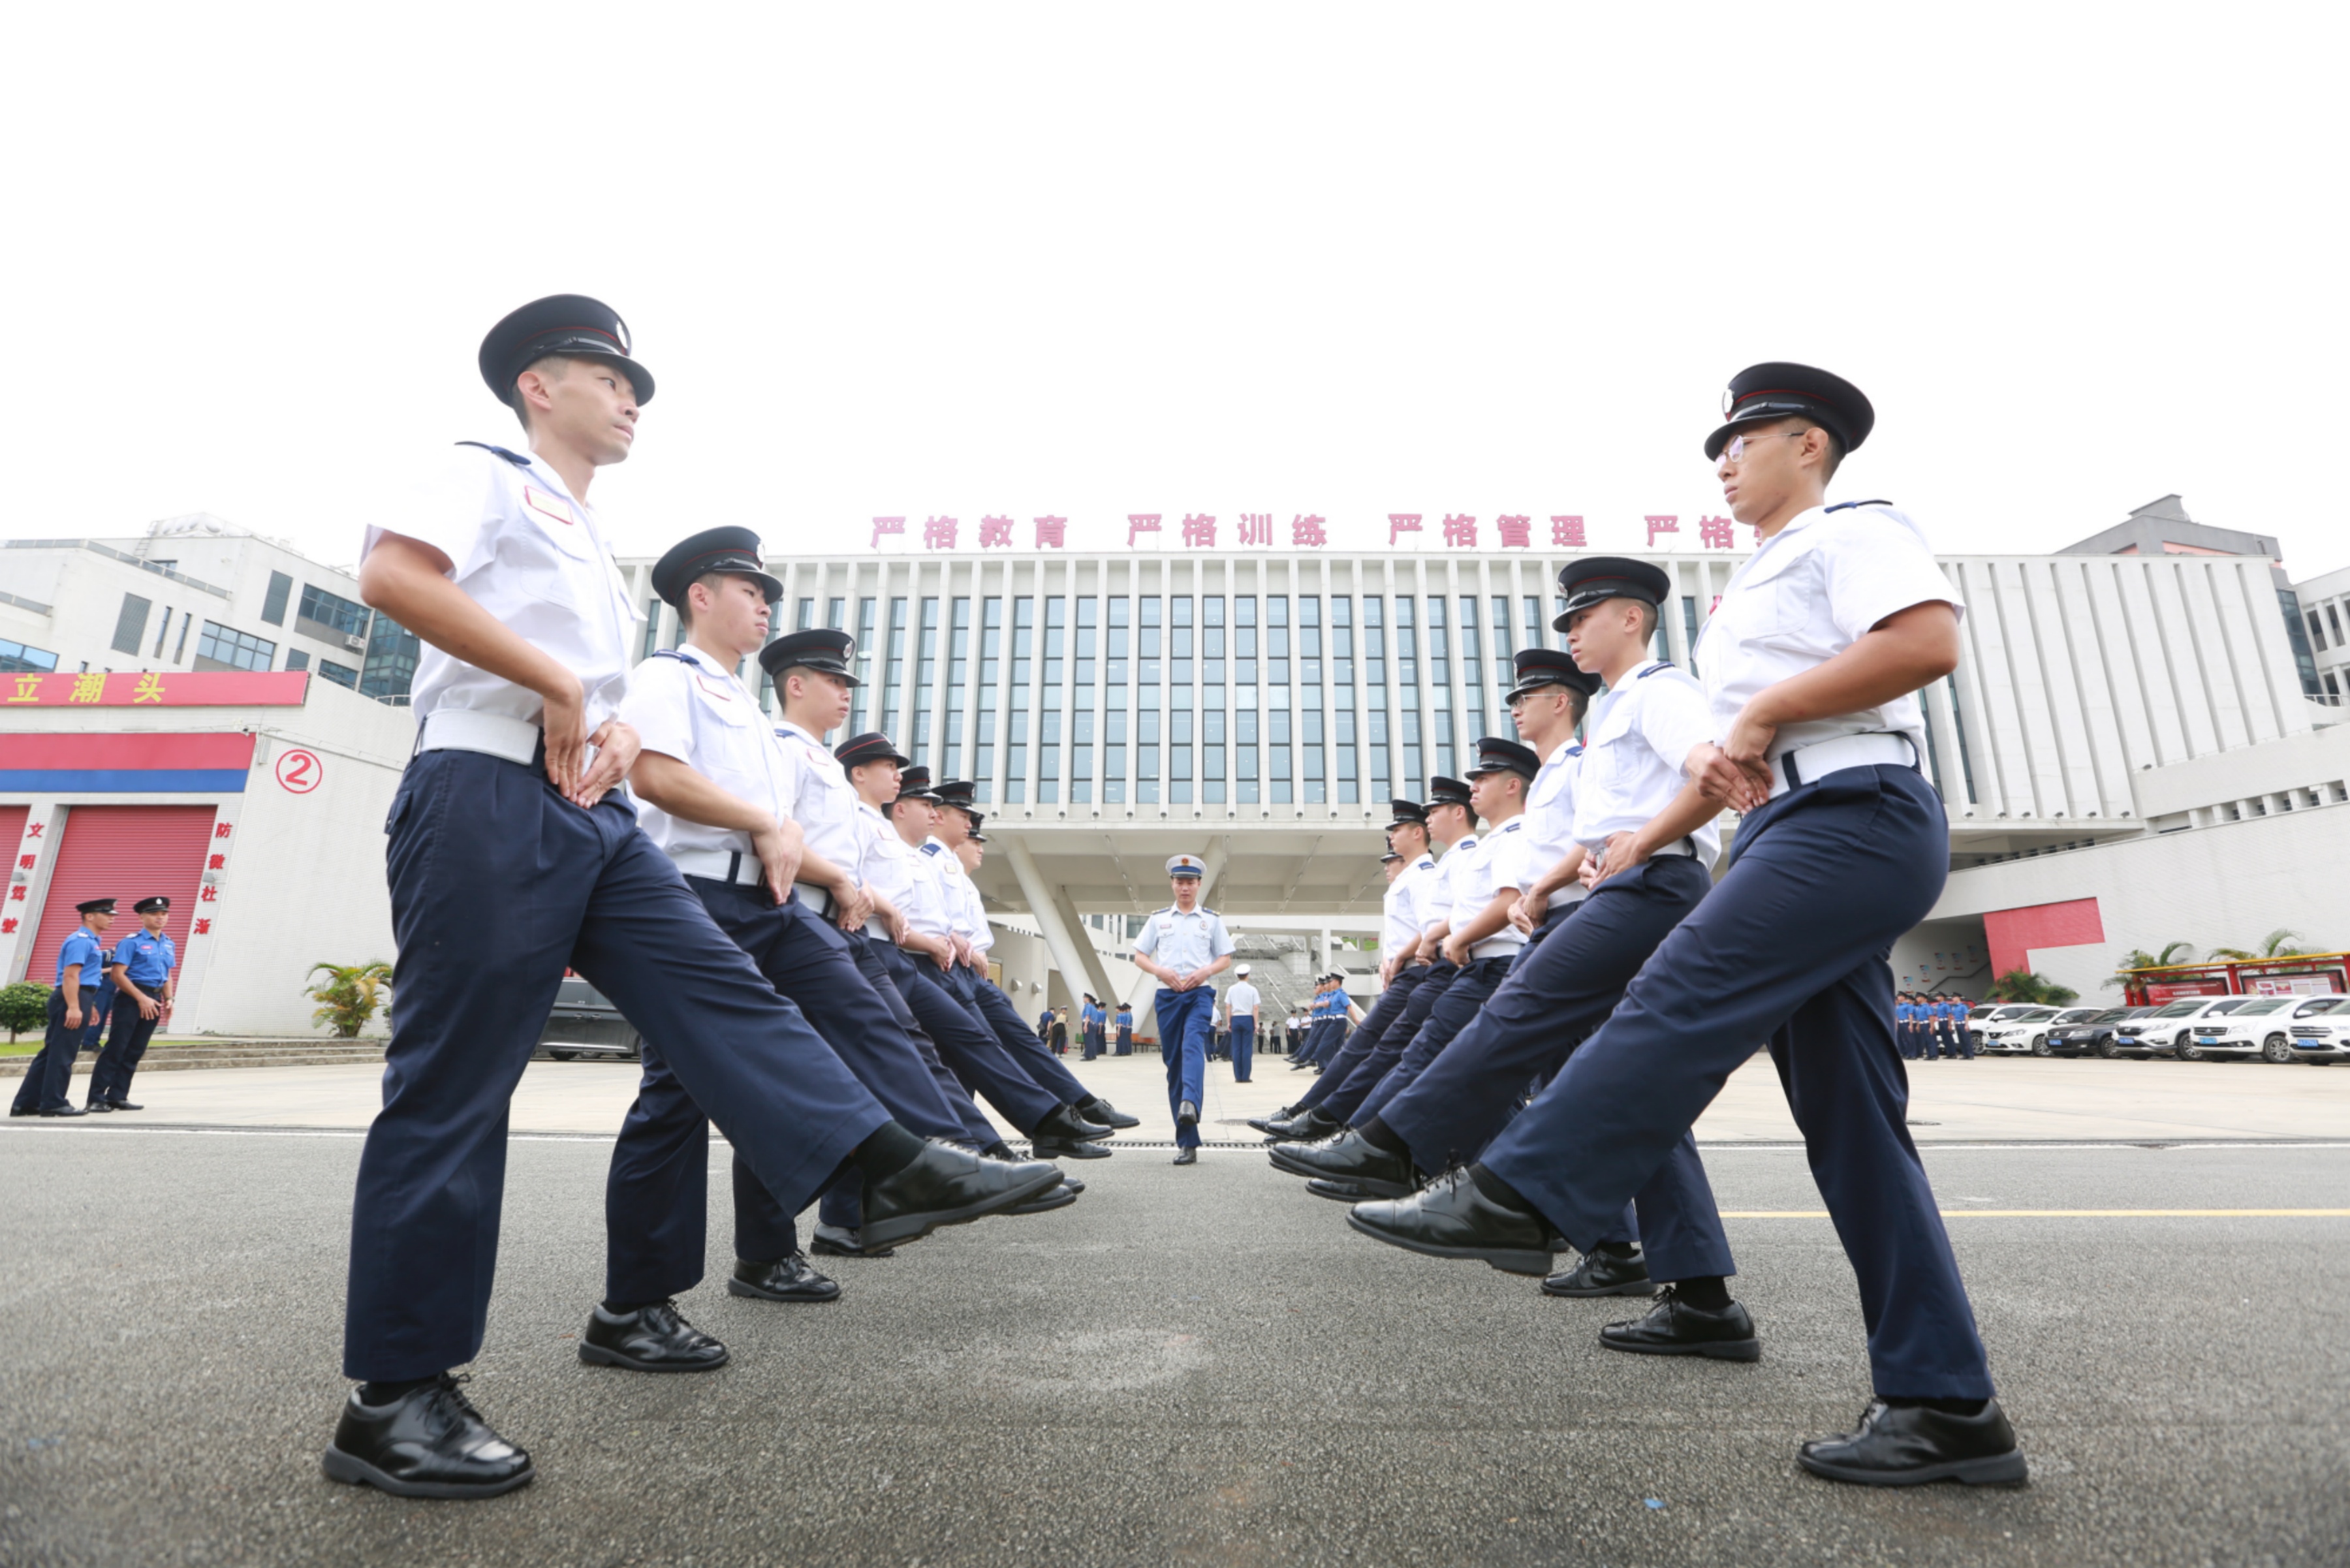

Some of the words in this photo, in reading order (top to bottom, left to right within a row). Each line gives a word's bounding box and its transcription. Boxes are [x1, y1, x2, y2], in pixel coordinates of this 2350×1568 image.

[871, 514, 1067, 548] 严格教育
[1127, 514, 1327, 547] 严格训练
[1388, 514, 1588, 547] 严格管理
[1645, 514, 1762, 548] 严格
[7, 673, 166, 703] 立潮头
[285, 754, 311, 785] 2
[1, 823, 44, 933] 文明驾驶
[194, 823, 232, 934] 防微杜渐
